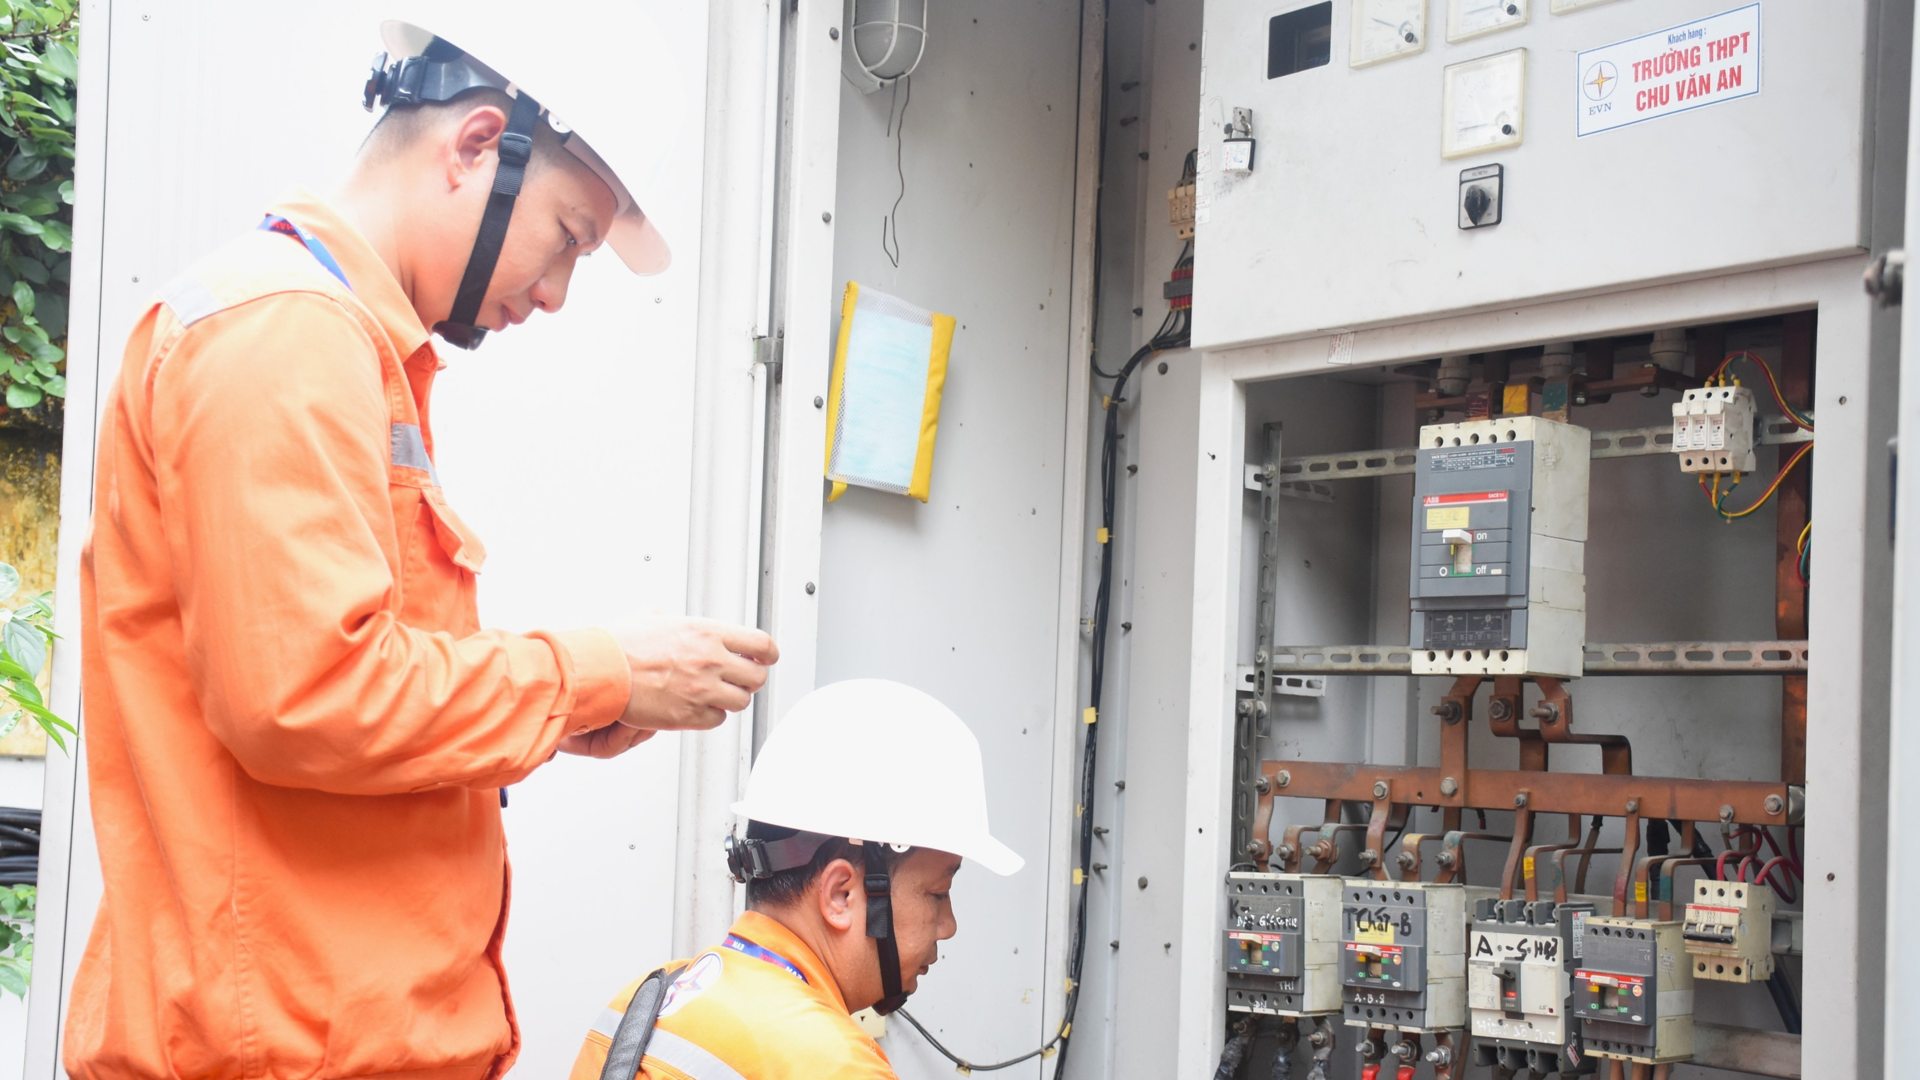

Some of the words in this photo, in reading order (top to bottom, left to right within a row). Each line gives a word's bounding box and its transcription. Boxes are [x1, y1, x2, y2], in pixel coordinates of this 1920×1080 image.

[1667, 31, 1687, 45] Khách
[1632, 45, 1701, 83] TRƯỜNG
[1706, 31, 1751, 63] THPT
[1636, 84, 1670, 112] CHU
[1676, 73, 1711, 102] VĂN
[1716, 65, 1742, 92] AN
[1588, 102, 1613, 116] EVN
[1476, 532, 1487, 540] on
[1475, 564, 1487, 575] off
